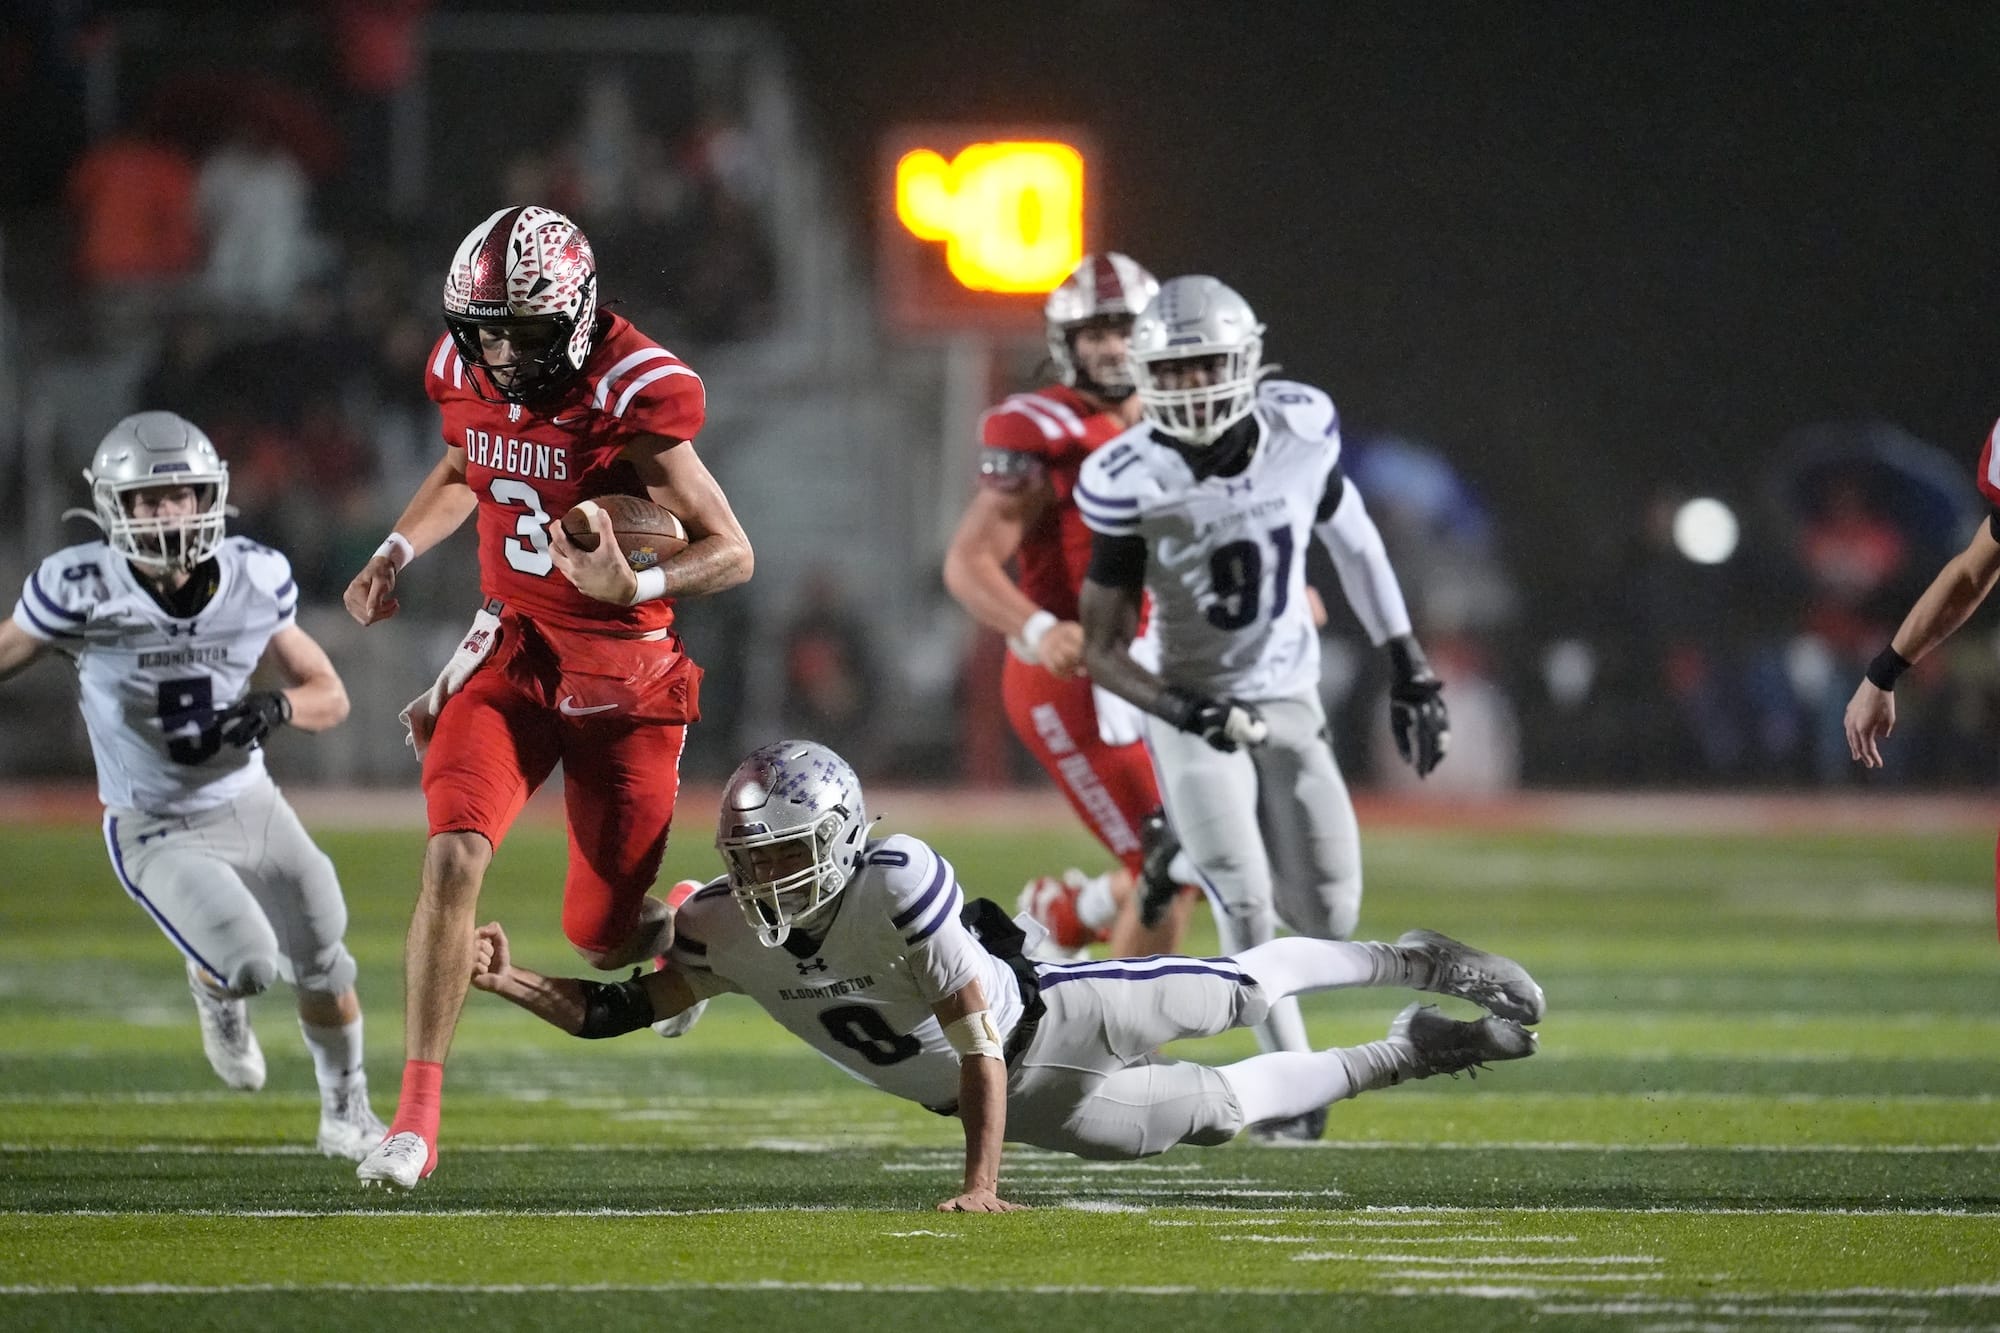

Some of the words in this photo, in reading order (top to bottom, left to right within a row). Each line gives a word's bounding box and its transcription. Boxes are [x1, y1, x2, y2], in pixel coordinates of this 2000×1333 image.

[468, 305, 508, 316] Riddell
[465, 428, 567, 480] DRAGONS
[489, 477, 554, 577] 3
[1206, 523, 1294, 632] 91
[868, 849, 909, 868] 0
[779, 975, 875, 1001] BLOOMINGTON
[818, 1004, 922, 1067] 0
